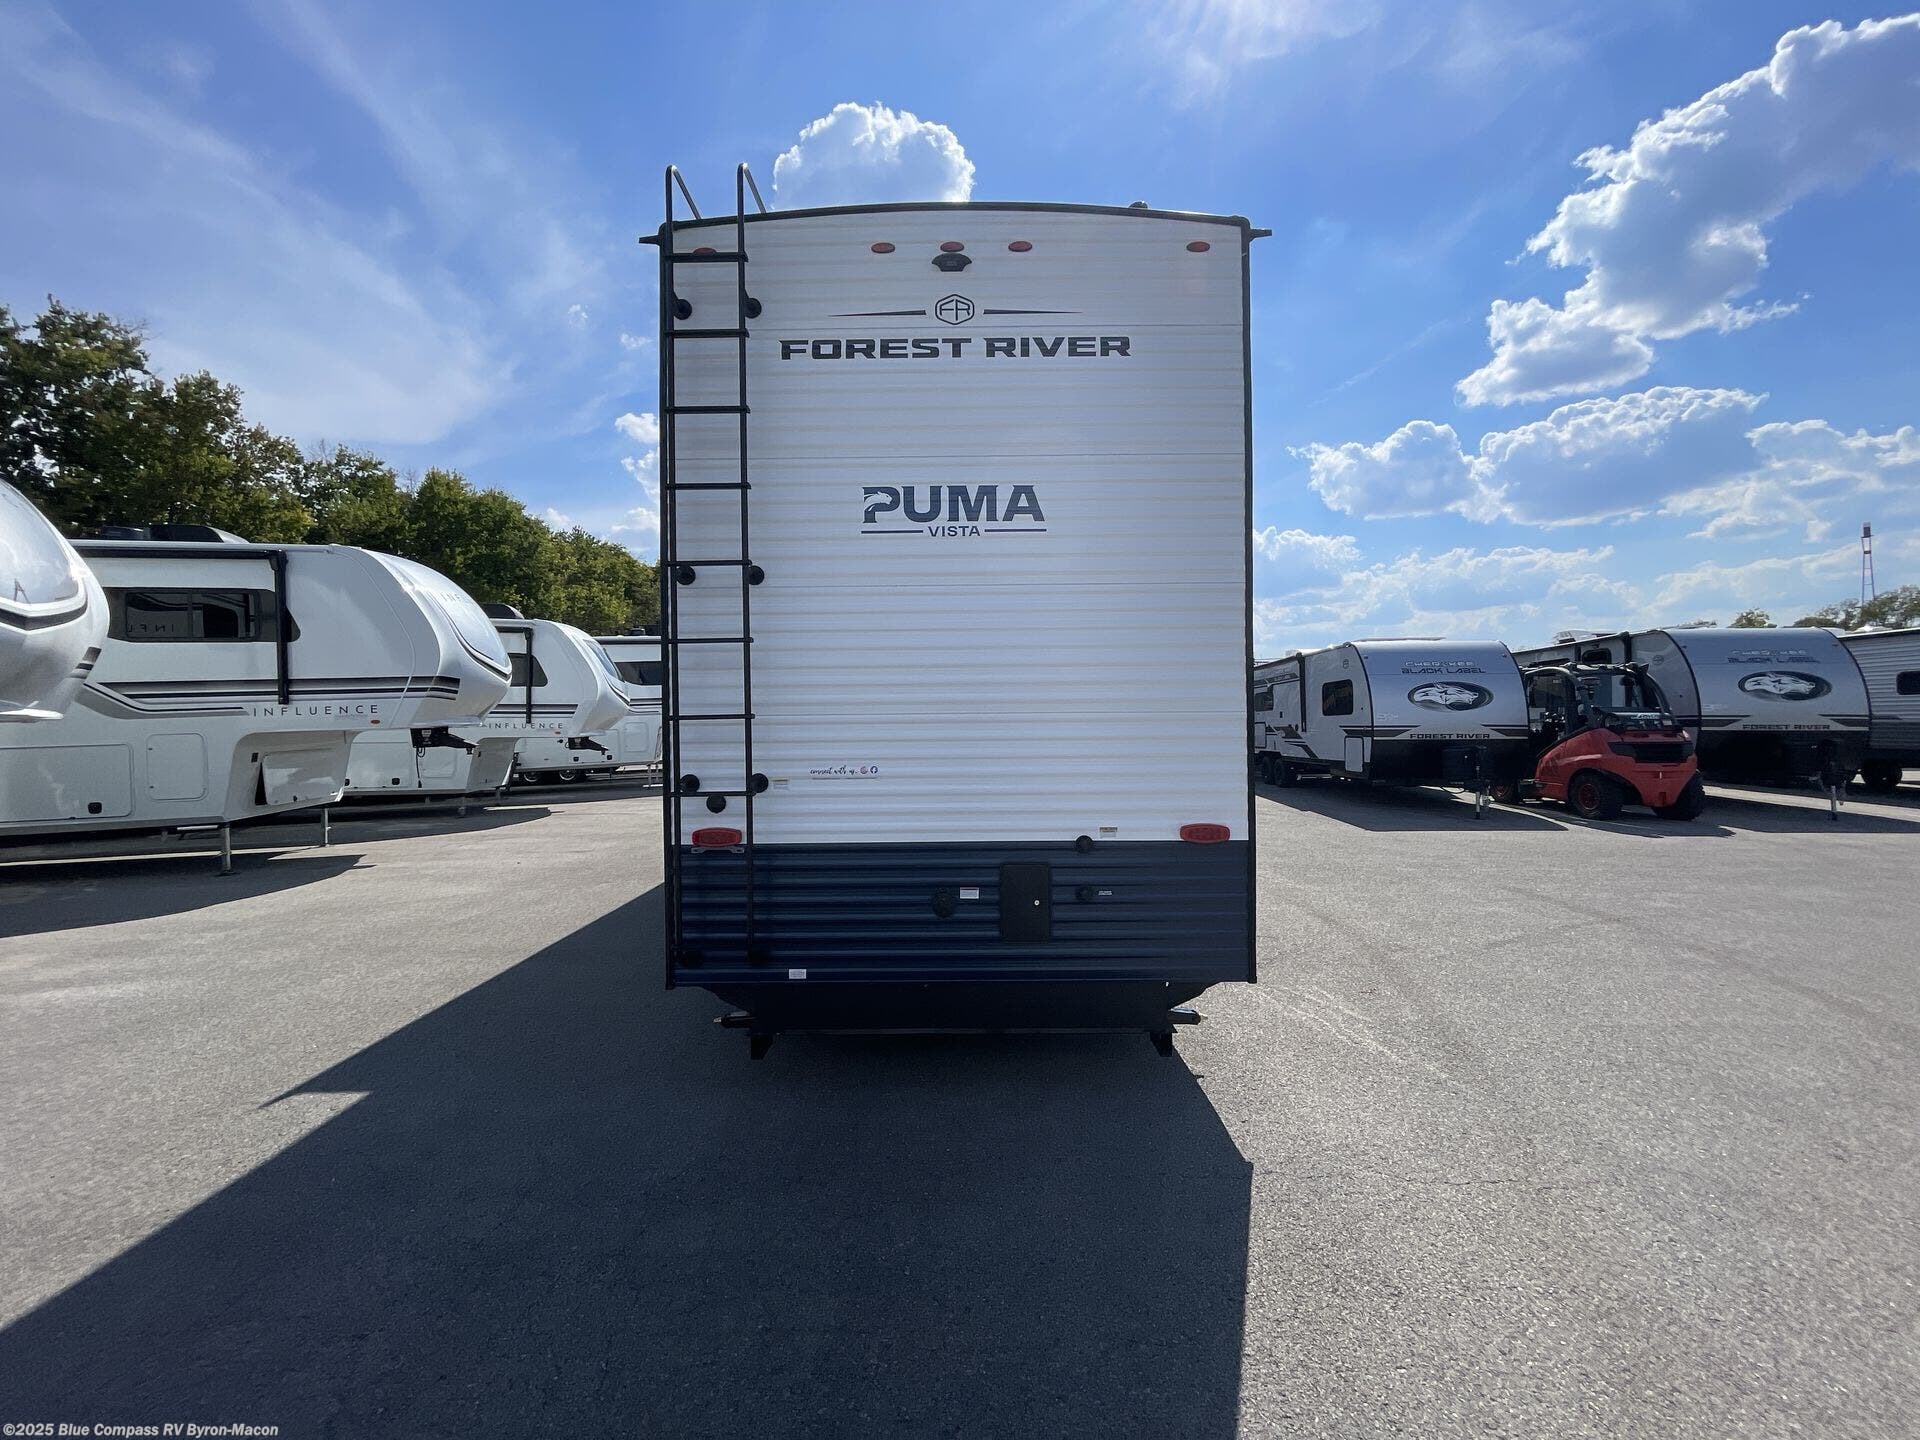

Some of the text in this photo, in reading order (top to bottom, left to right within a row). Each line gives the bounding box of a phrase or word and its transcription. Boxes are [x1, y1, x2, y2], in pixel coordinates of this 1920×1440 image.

[938, 297, 972, 322] FR
[778, 335, 1132, 361] FOREST RIVER
[861, 484, 1046, 524] PUMA
[927, 525, 981, 538] VISTA
[253, 704, 379, 718] INFLUENCE
